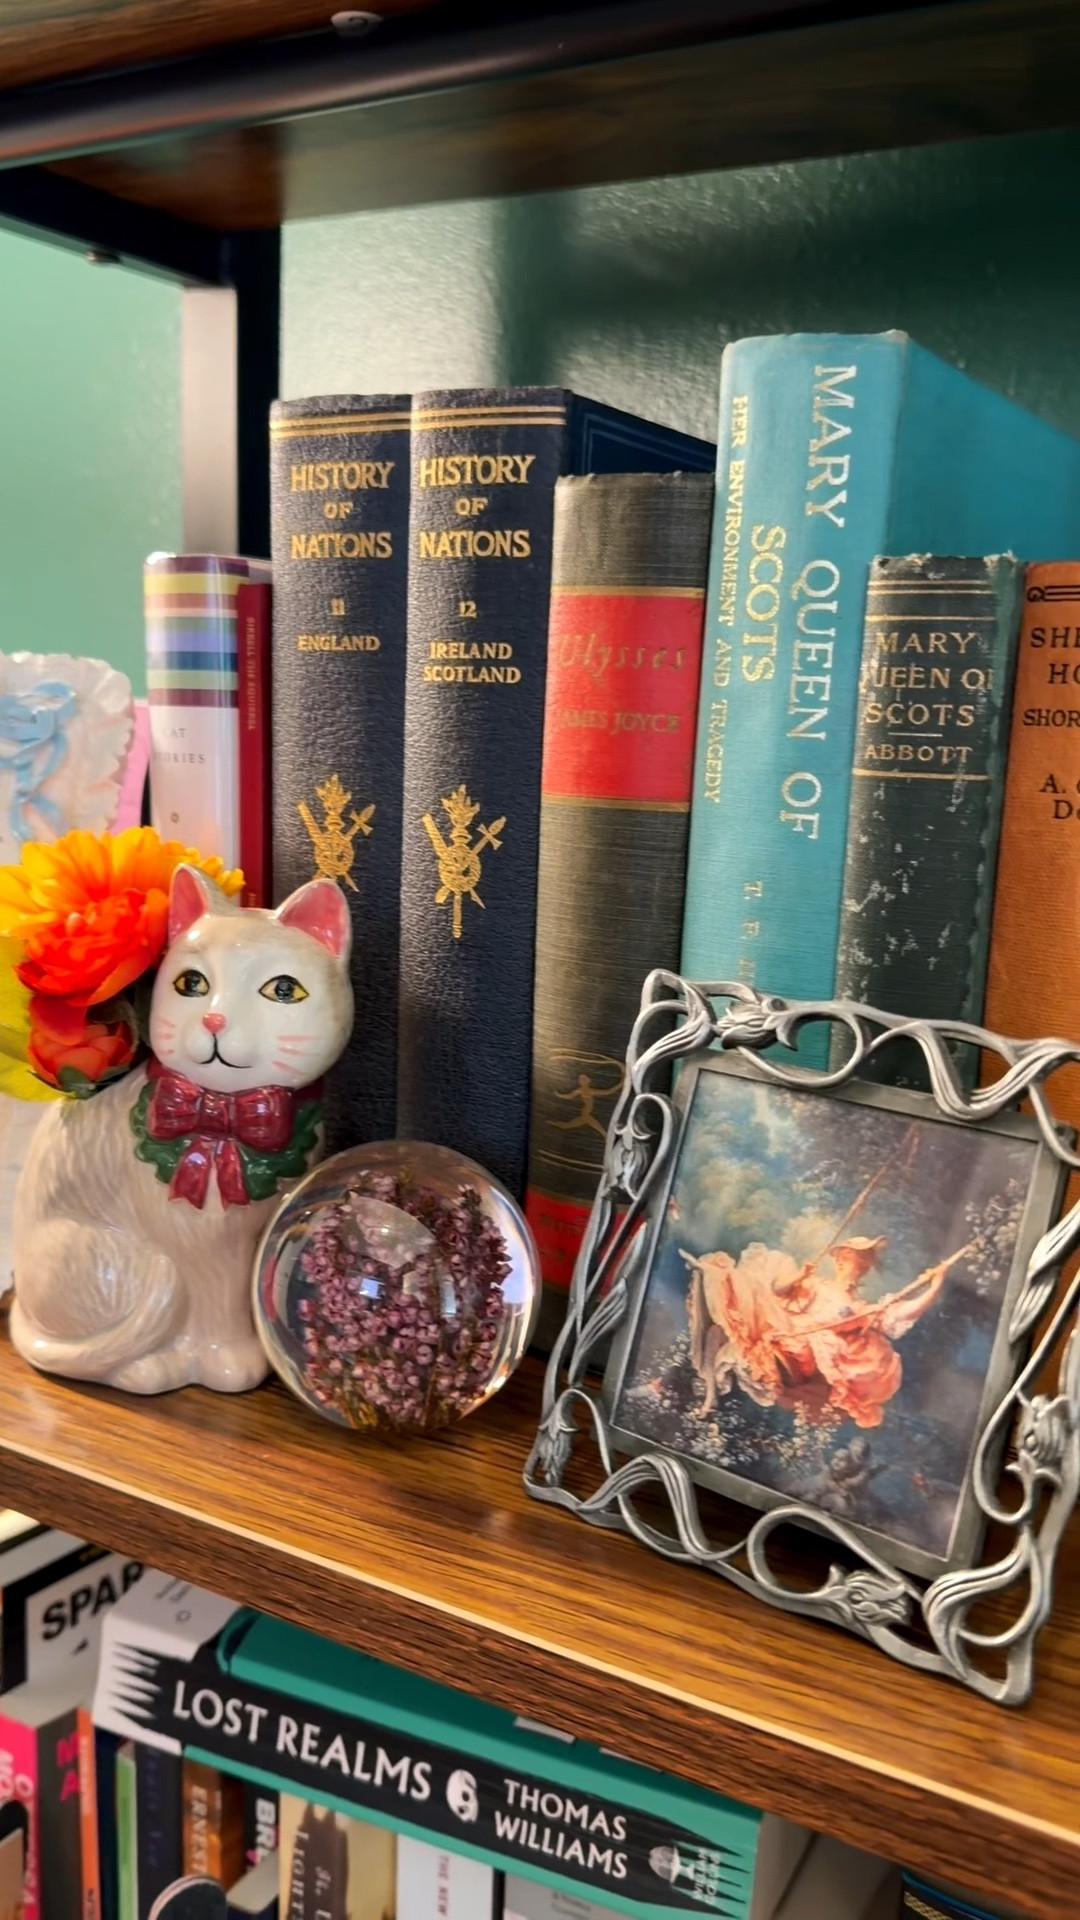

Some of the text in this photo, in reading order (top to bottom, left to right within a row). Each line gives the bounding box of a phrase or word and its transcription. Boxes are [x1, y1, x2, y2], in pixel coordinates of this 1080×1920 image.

[290, 462, 395, 492] HISTORY
[419, 454, 536, 488] HISTORY
[323, 501, 353, 520] OF
[455, 497, 488, 516] OF
[290, 532, 393, 560] NATIONS
[419, 529, 531, 559] NATIONS
[330, 598, 345, 616] 11
[458, 601, 477, 618] 12
[704, 395, 749, 803] HER ENVIRONMENT AND TRAGEDY
[740, 524, 787, 683] SCOTS
[780, 365, 857, 840] MARY QUEEN OF
[297, 635, 381, 652] ENGLAND
[428, 641, 513, 660] IRELAND
[875, 632, 976, 655] MARY
[1030, 627, 1080, 649] SH
[558, 633, 685, 679] Ulysses
[422, 667, 521, 684] SCOTLAND
[860, 667, 950, 692] UEEN
[610, 711, 681, 736] JOYCE
[864, 703, 976, 727] SCOTS
[864, 744, 973, 765] ABBOTT
[172, 1680, 432, 1802] LOST REALMS
[503, 1778, 628, 1842] THOMAS
[494, 1810, 629, 1880] WILLIAMS
